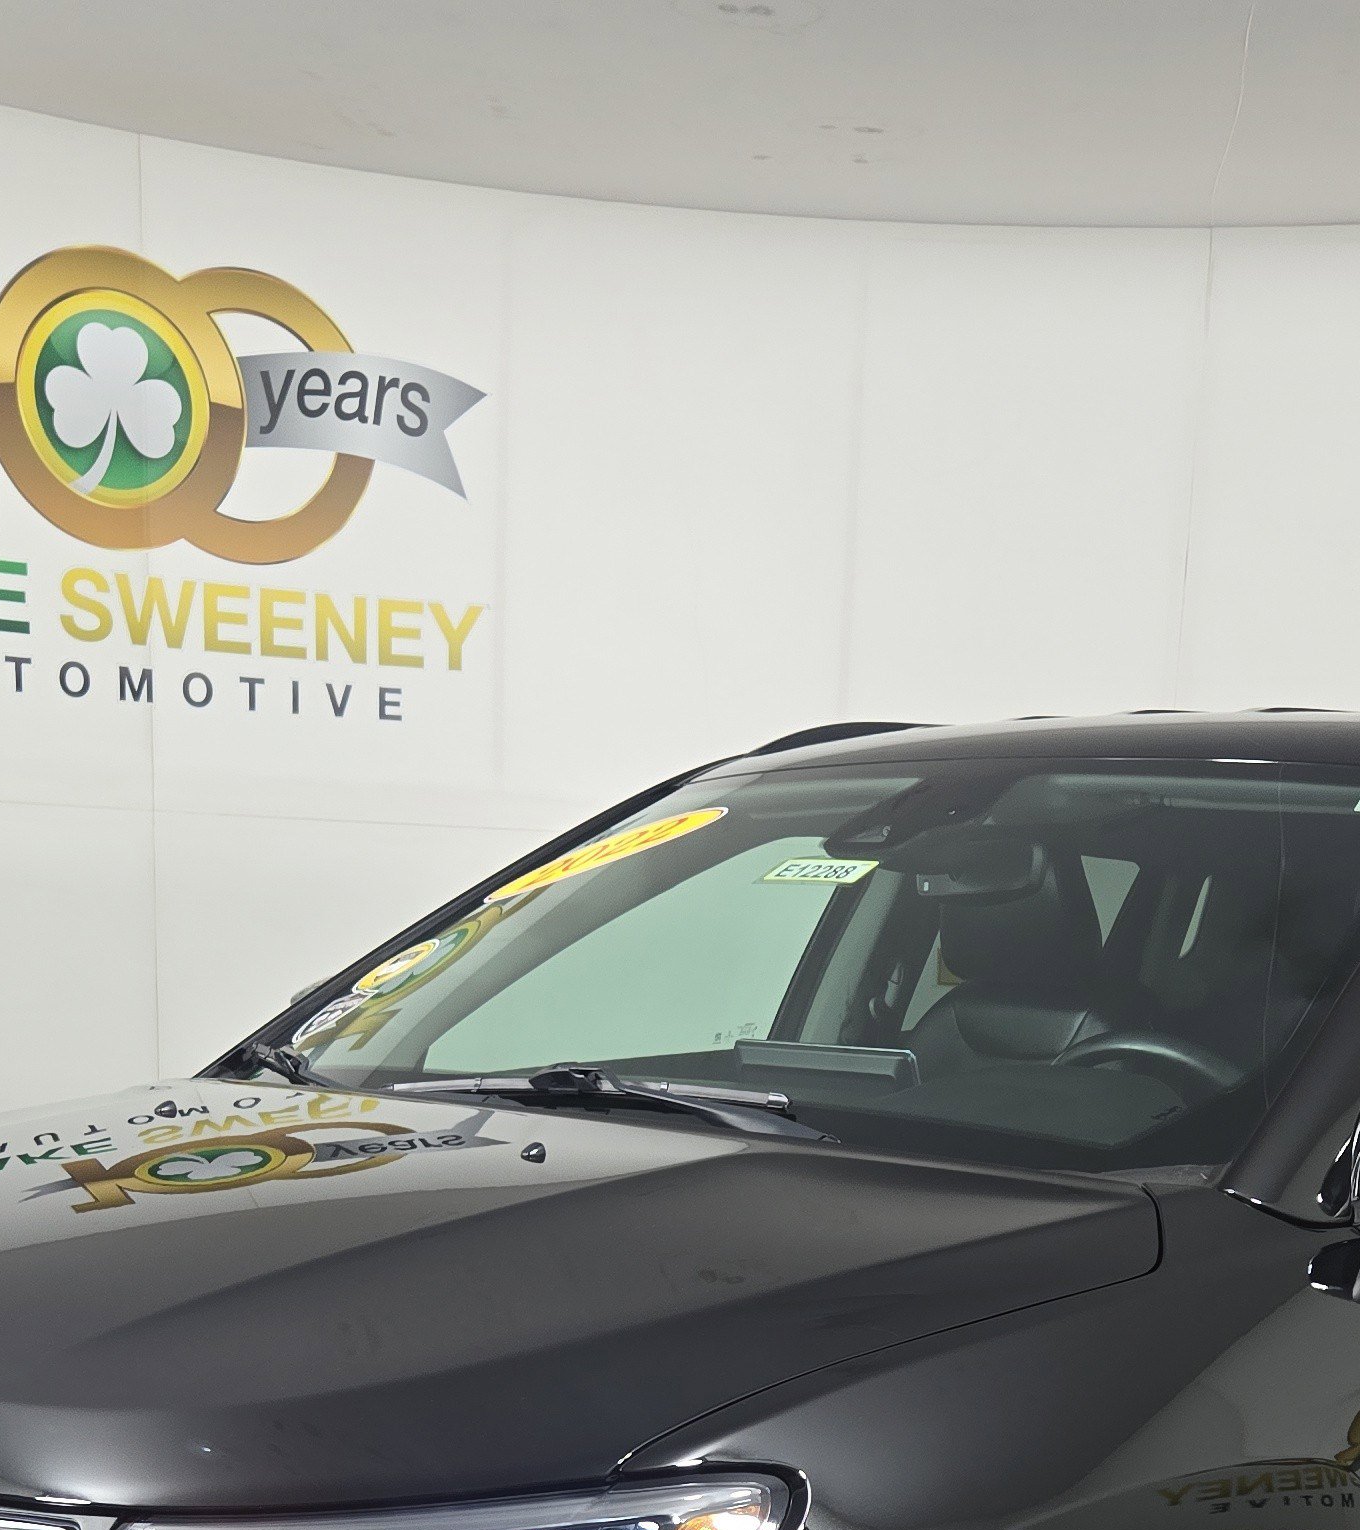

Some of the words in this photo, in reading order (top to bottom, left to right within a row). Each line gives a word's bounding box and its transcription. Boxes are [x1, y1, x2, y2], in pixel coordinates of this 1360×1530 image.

[257, 367, 432, 437] years
[59, 567, 485, 672] SWEENEY
[519, 817, 689, 890] 2022
[774, 863, 858, 880] E12288
